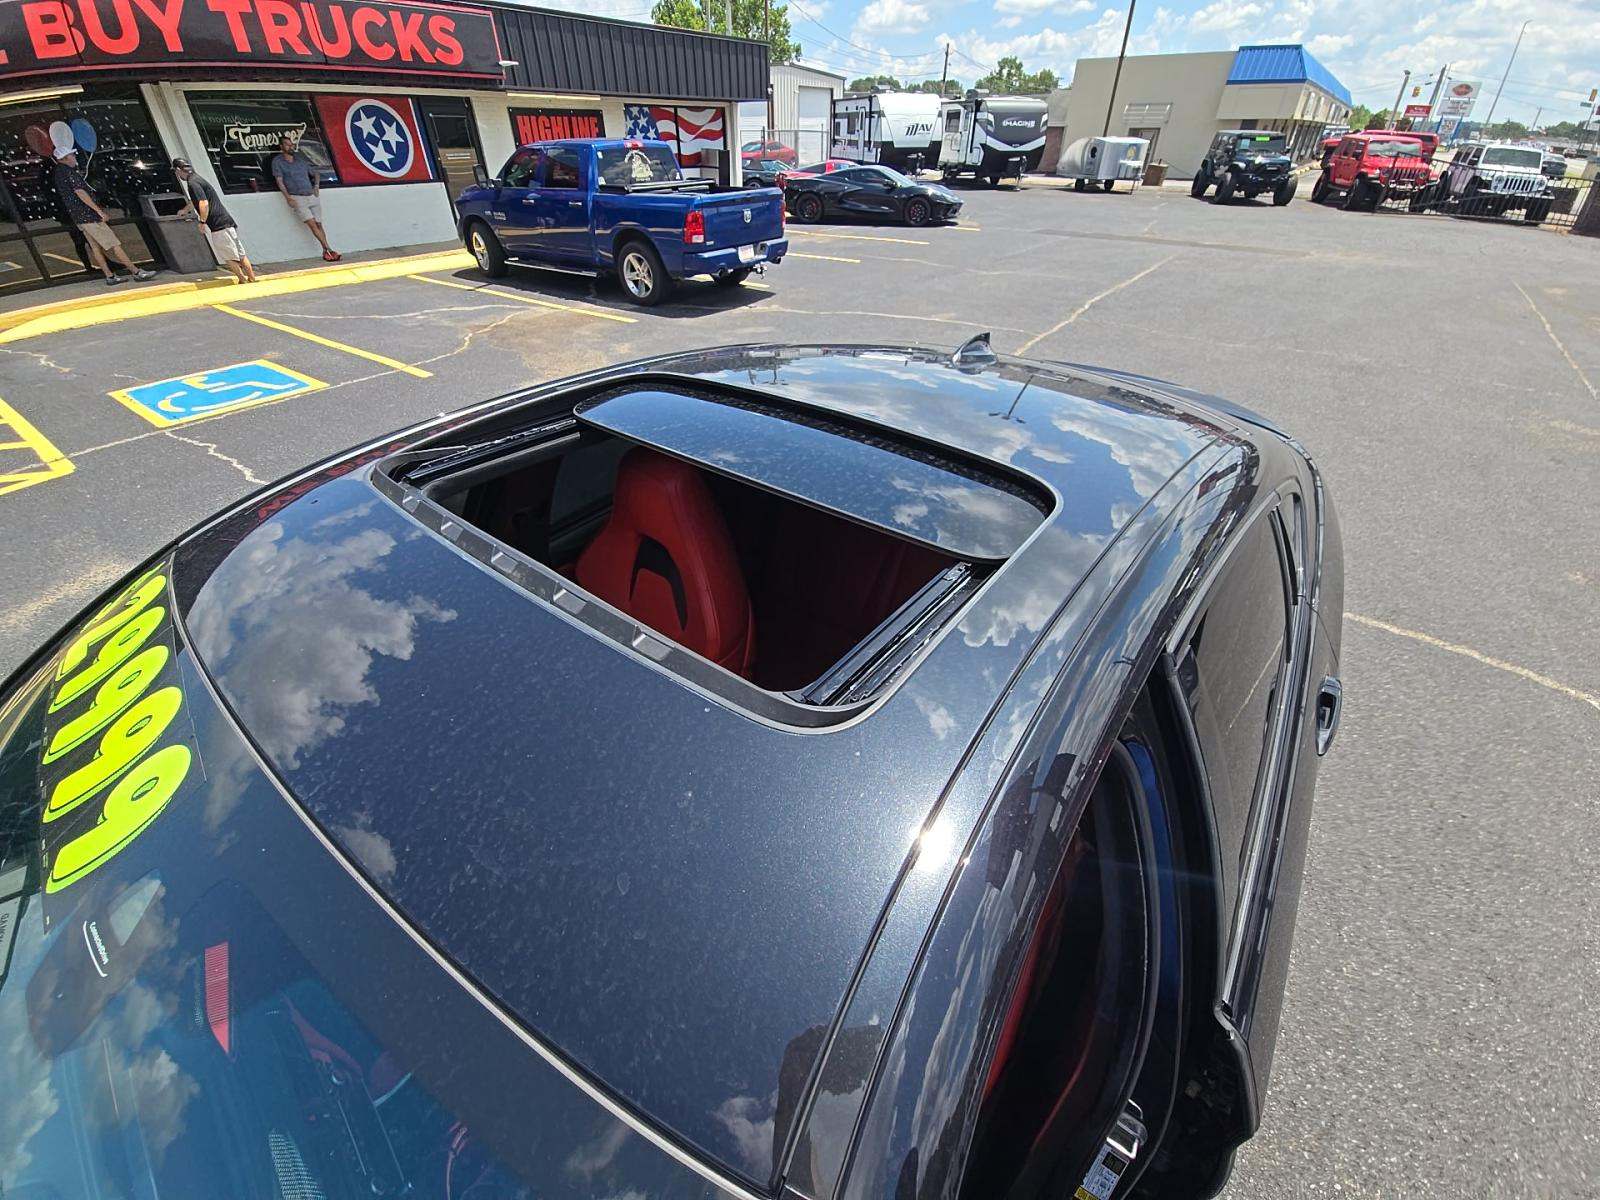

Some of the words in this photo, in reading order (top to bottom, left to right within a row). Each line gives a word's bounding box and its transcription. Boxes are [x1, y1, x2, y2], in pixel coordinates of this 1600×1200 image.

[21, 0, 184, 59] BUY
[206, 0, 464, 65] TRUCKS
[1002, 119, 1035, 128] IMAGINE
[229, 126, 299, 150] Tennesee
